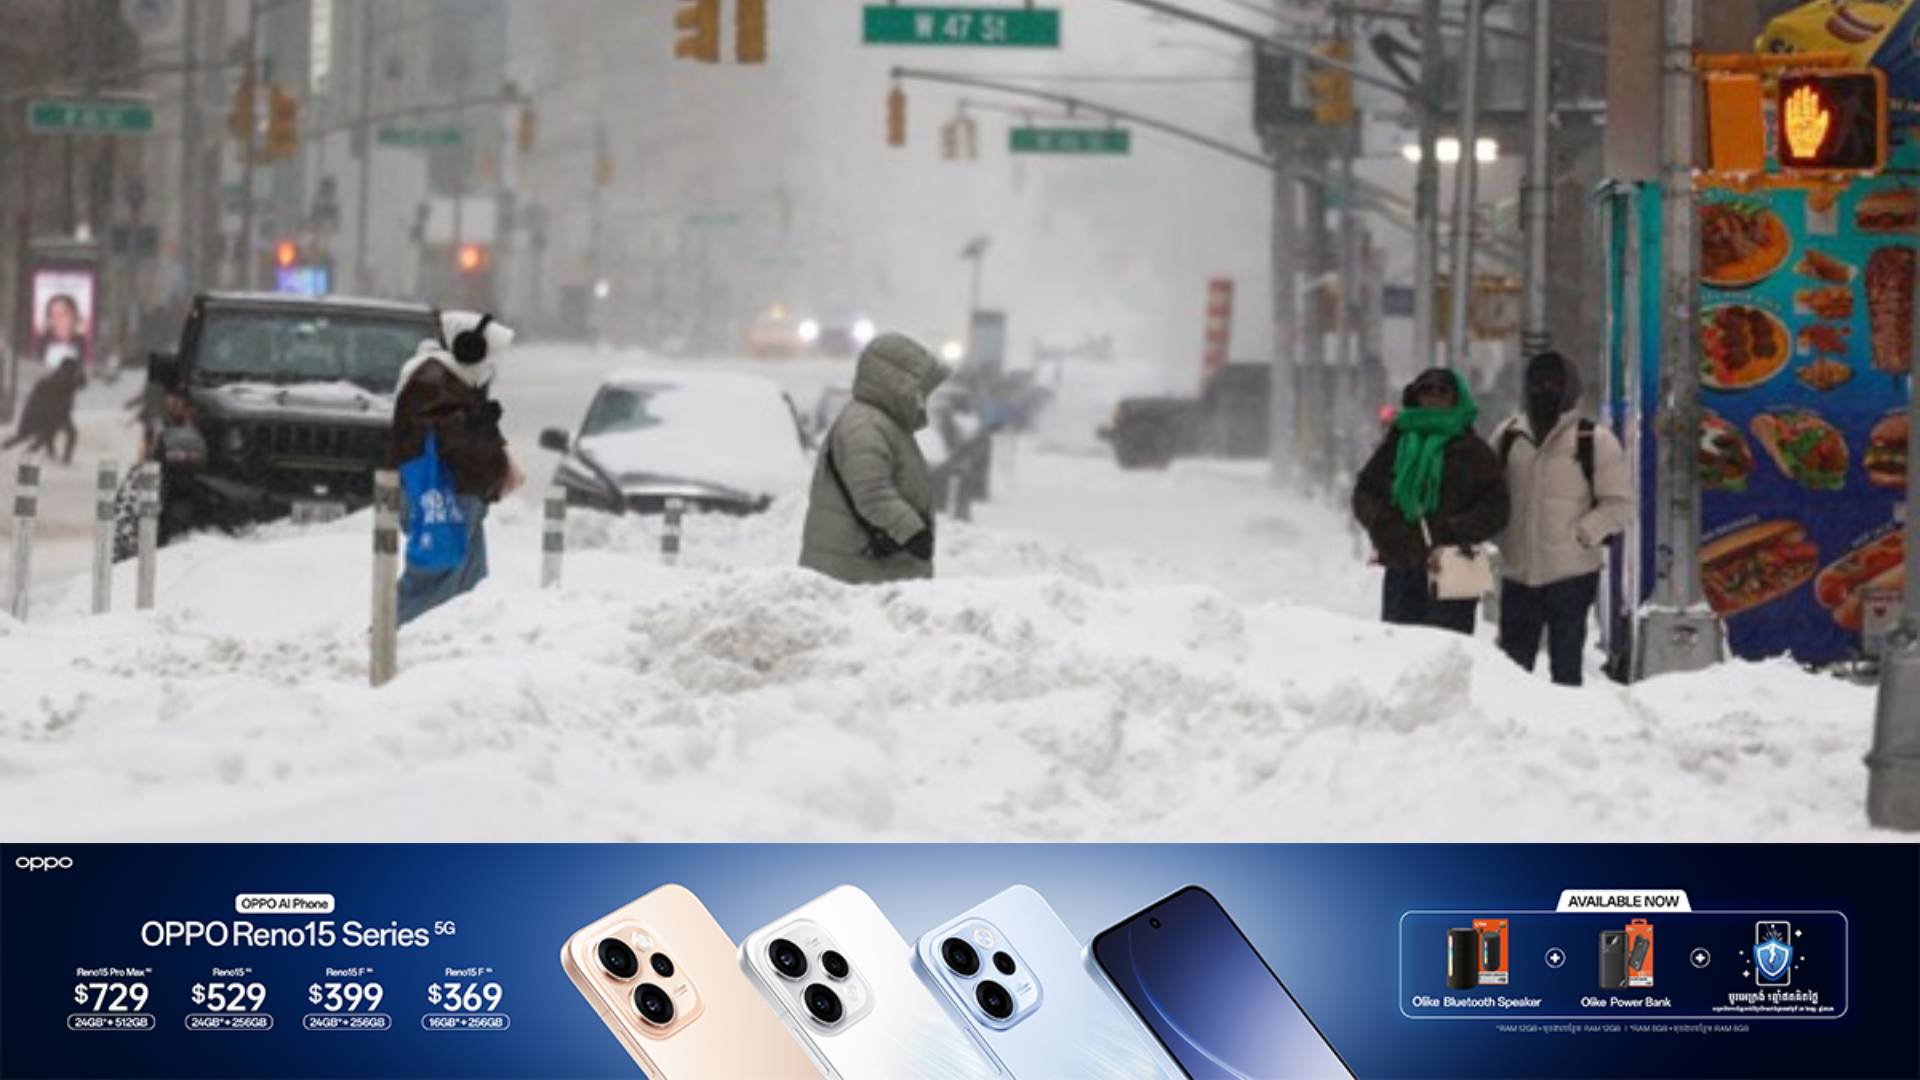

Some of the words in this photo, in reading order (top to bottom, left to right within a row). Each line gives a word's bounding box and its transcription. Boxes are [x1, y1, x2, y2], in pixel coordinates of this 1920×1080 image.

[916, 15, 934, 37] W
[943, 14, 972, 38] 47
[982, 14, 1006, 40] St
